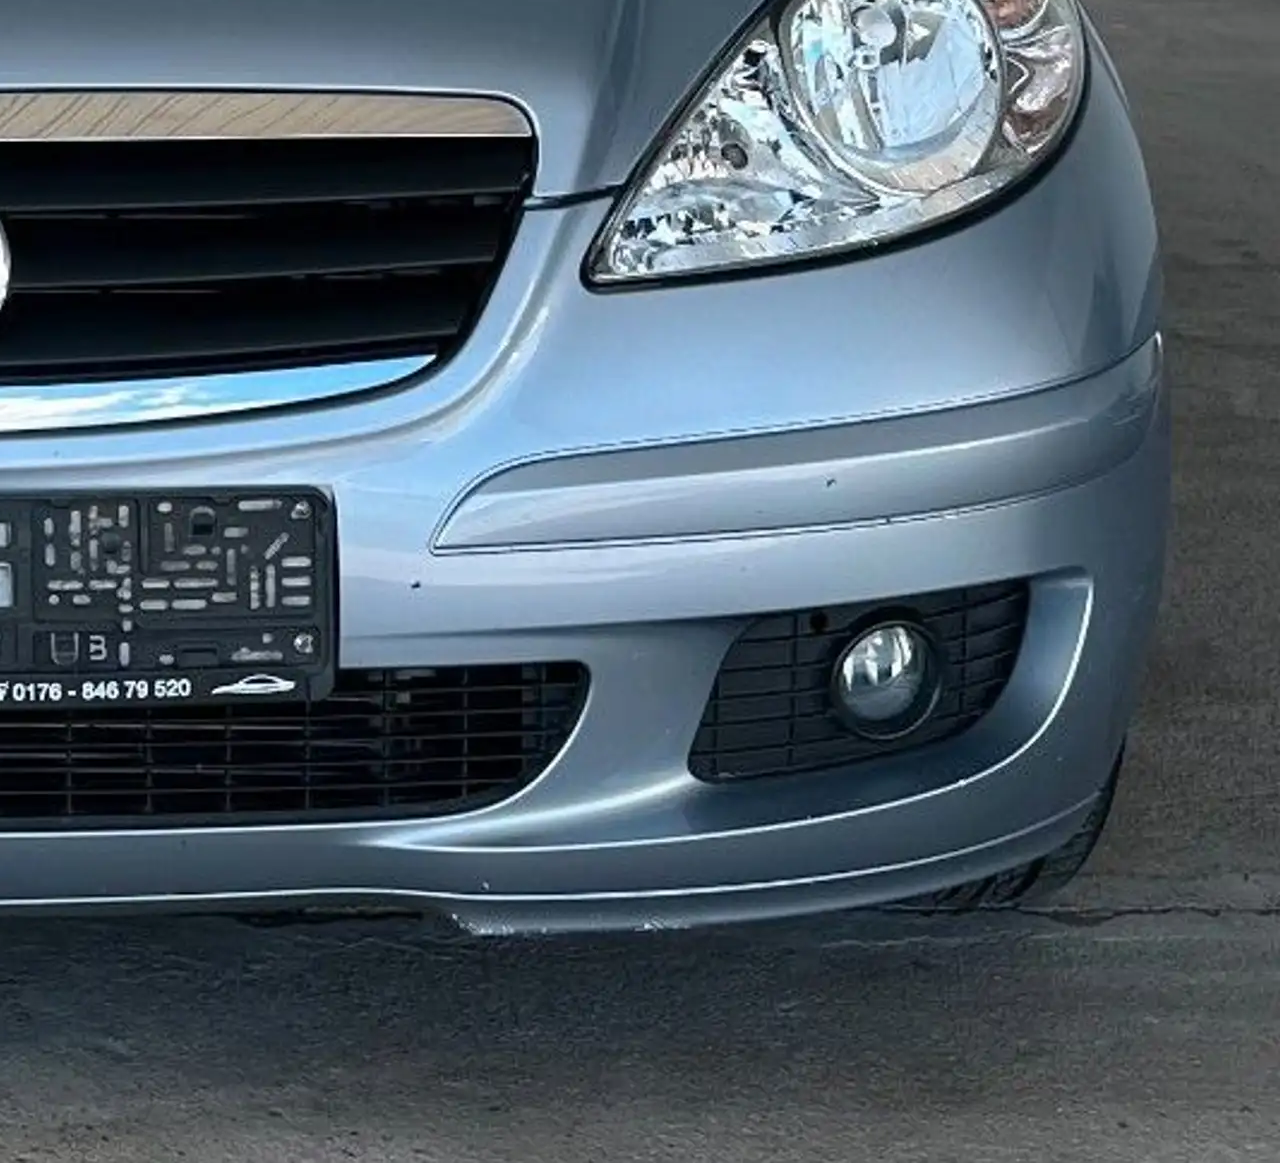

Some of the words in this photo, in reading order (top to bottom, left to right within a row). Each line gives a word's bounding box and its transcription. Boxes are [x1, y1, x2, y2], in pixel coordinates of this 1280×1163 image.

[11, 683, 63, 702] 0176
[81, 681, 120, 701] 846
[124, 680, 149, 700] 79
[153, 678, 192, 698] 520
